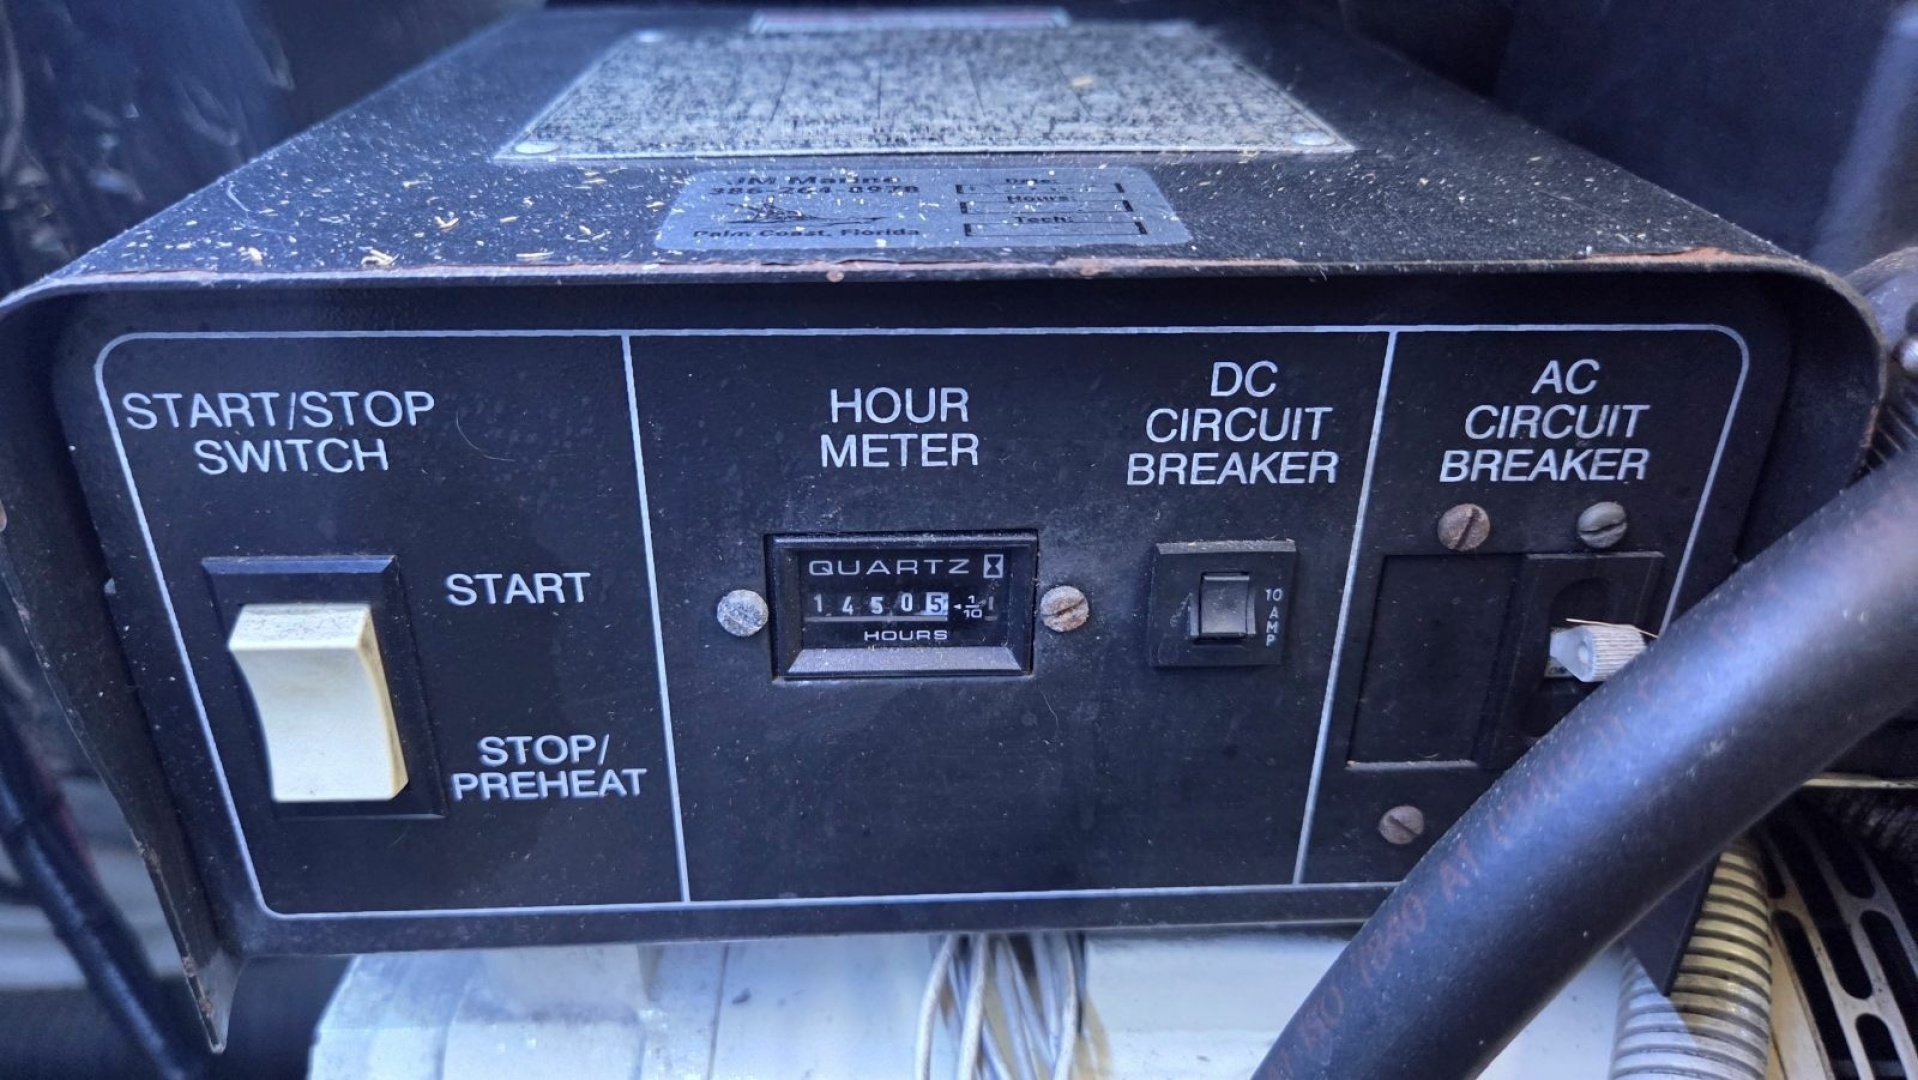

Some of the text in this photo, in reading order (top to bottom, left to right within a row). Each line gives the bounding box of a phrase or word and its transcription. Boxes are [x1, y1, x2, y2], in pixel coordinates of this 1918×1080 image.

[841, 228, 920, 236] Florida
[1210, 361, 1279, 398] DC
[1531, 358, 1600, 394] AC
[121, 390, 436, 431] START/STOP
[830, 386, 970, 424] HOUR
[1464, 404, 1650, 440] CIRCUIT
[1145, 406, 1333, 443] CIRCUIT
[194, 437, 390, 476] SWITCH
[820, 433, 980, 468] METER
[1439, 448, 1650, 482] BREAKER
[1125, 451, 1340, 487] BREAKER
[808, 559, 970, 577] QUARTZ
[445, 572, 591, 607] START
[863, 630, 948, 641] HOURS
[1265, 588, 1284, 647] 10 AMP
[479, 734, 611, 767] STOP/
[452, 768, 648, 801] PREHEAT
